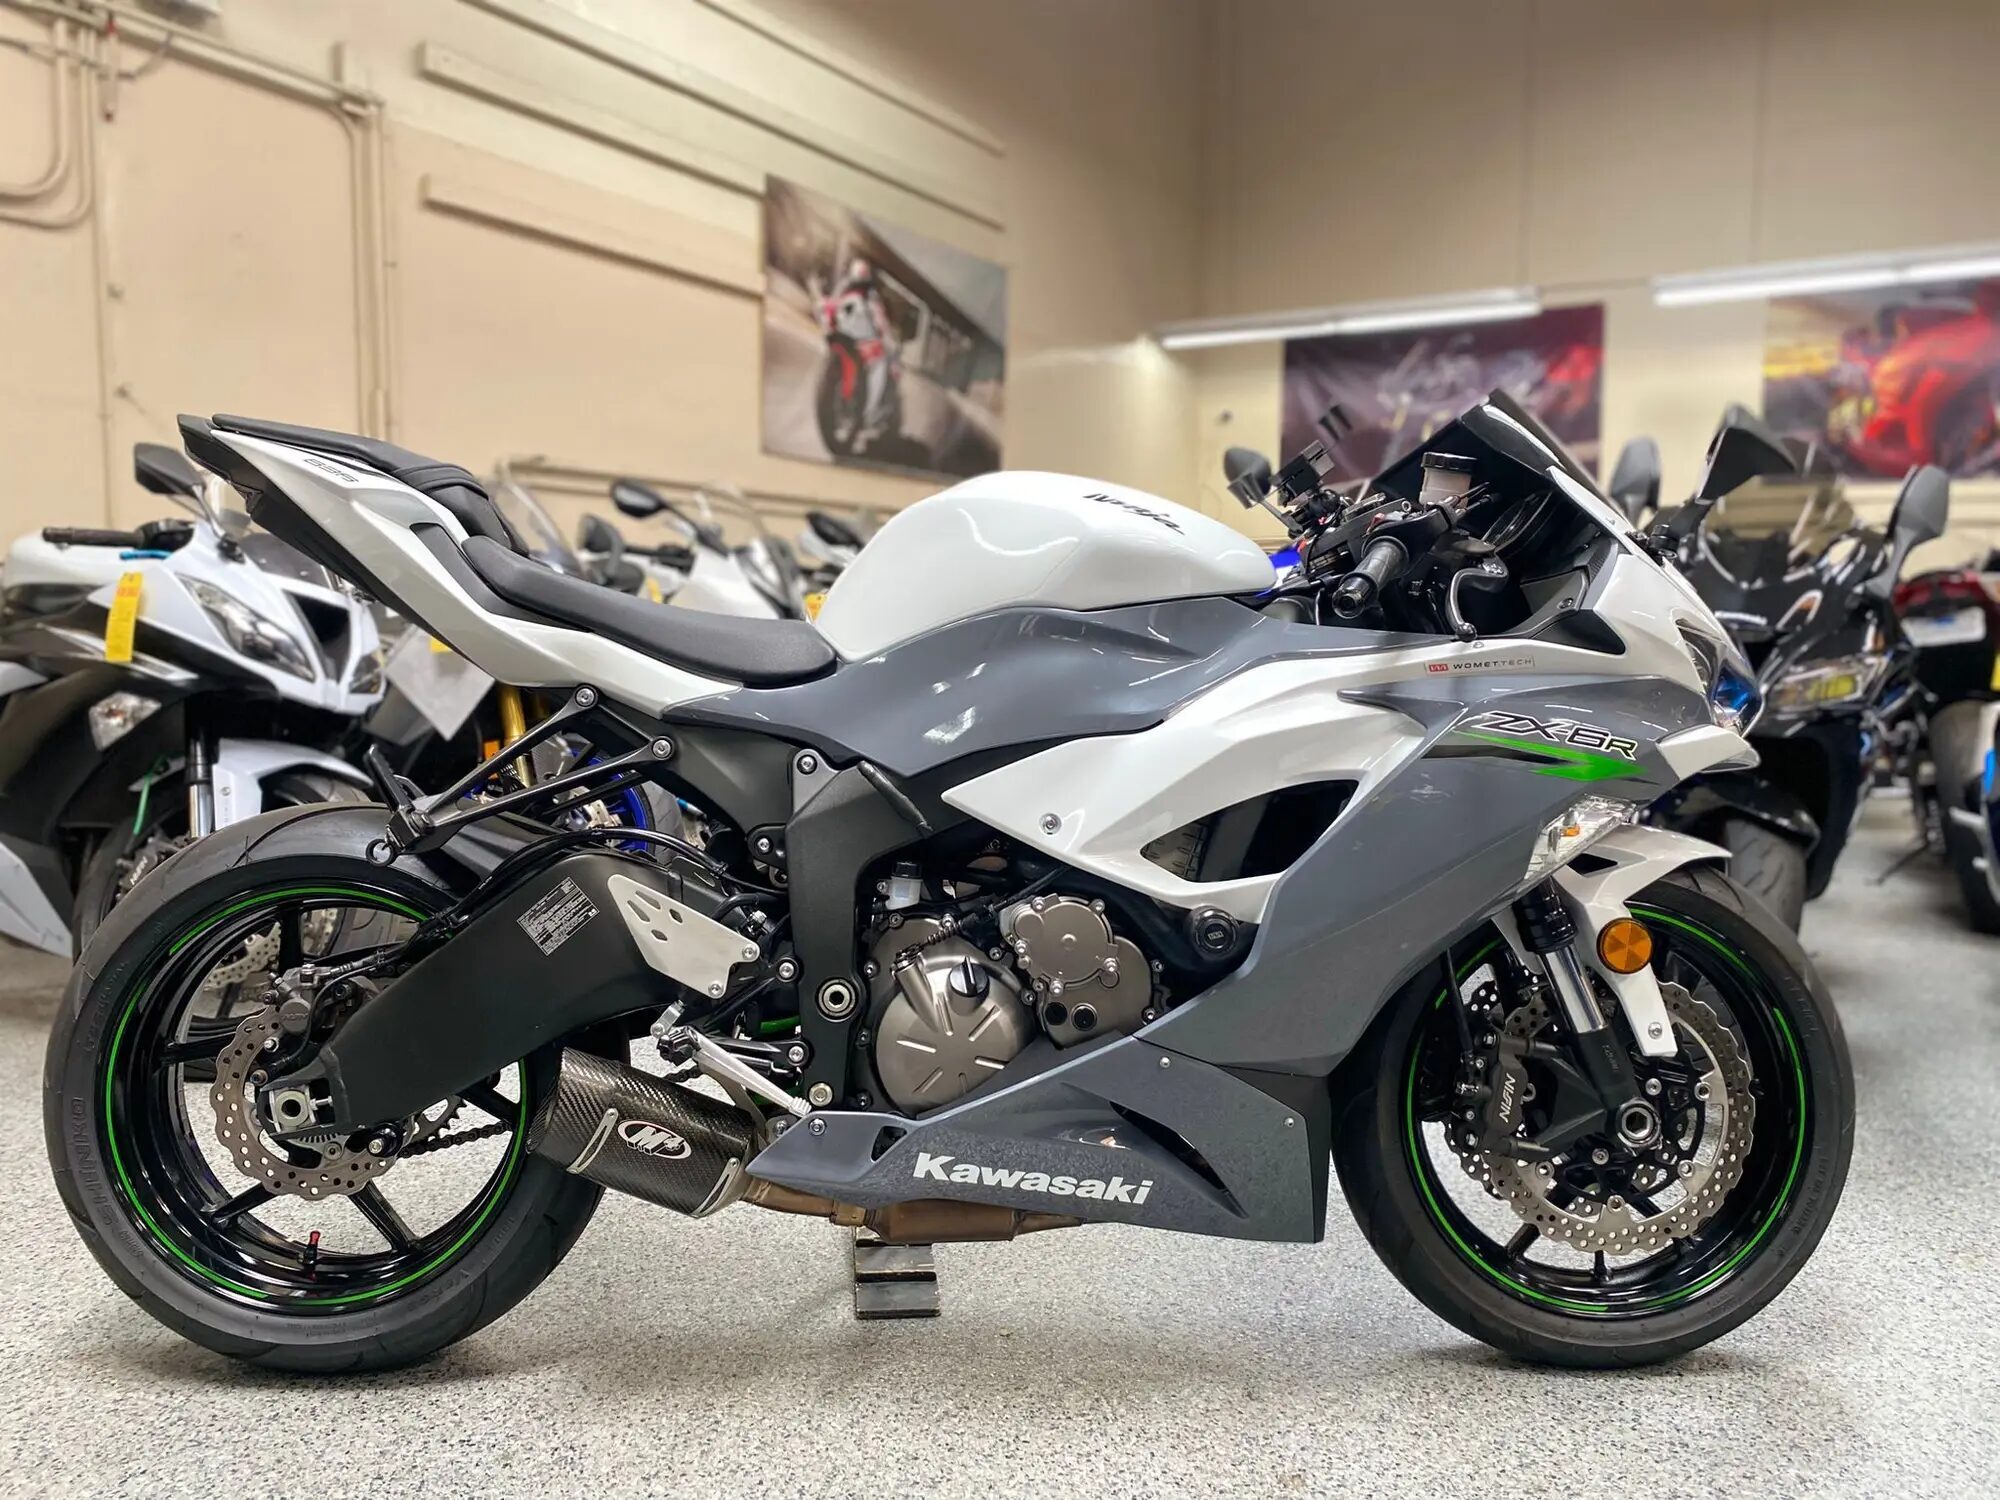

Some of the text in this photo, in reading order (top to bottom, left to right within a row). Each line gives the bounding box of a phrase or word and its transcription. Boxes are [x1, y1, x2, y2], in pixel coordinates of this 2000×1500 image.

[303, 458, 359, 483] 636
[1082, 493, 1185, 535] Ninja
[1471, 710, 1638, 761] ZX-6R
[912, 1151, 1154, 1205] Kawasaki
